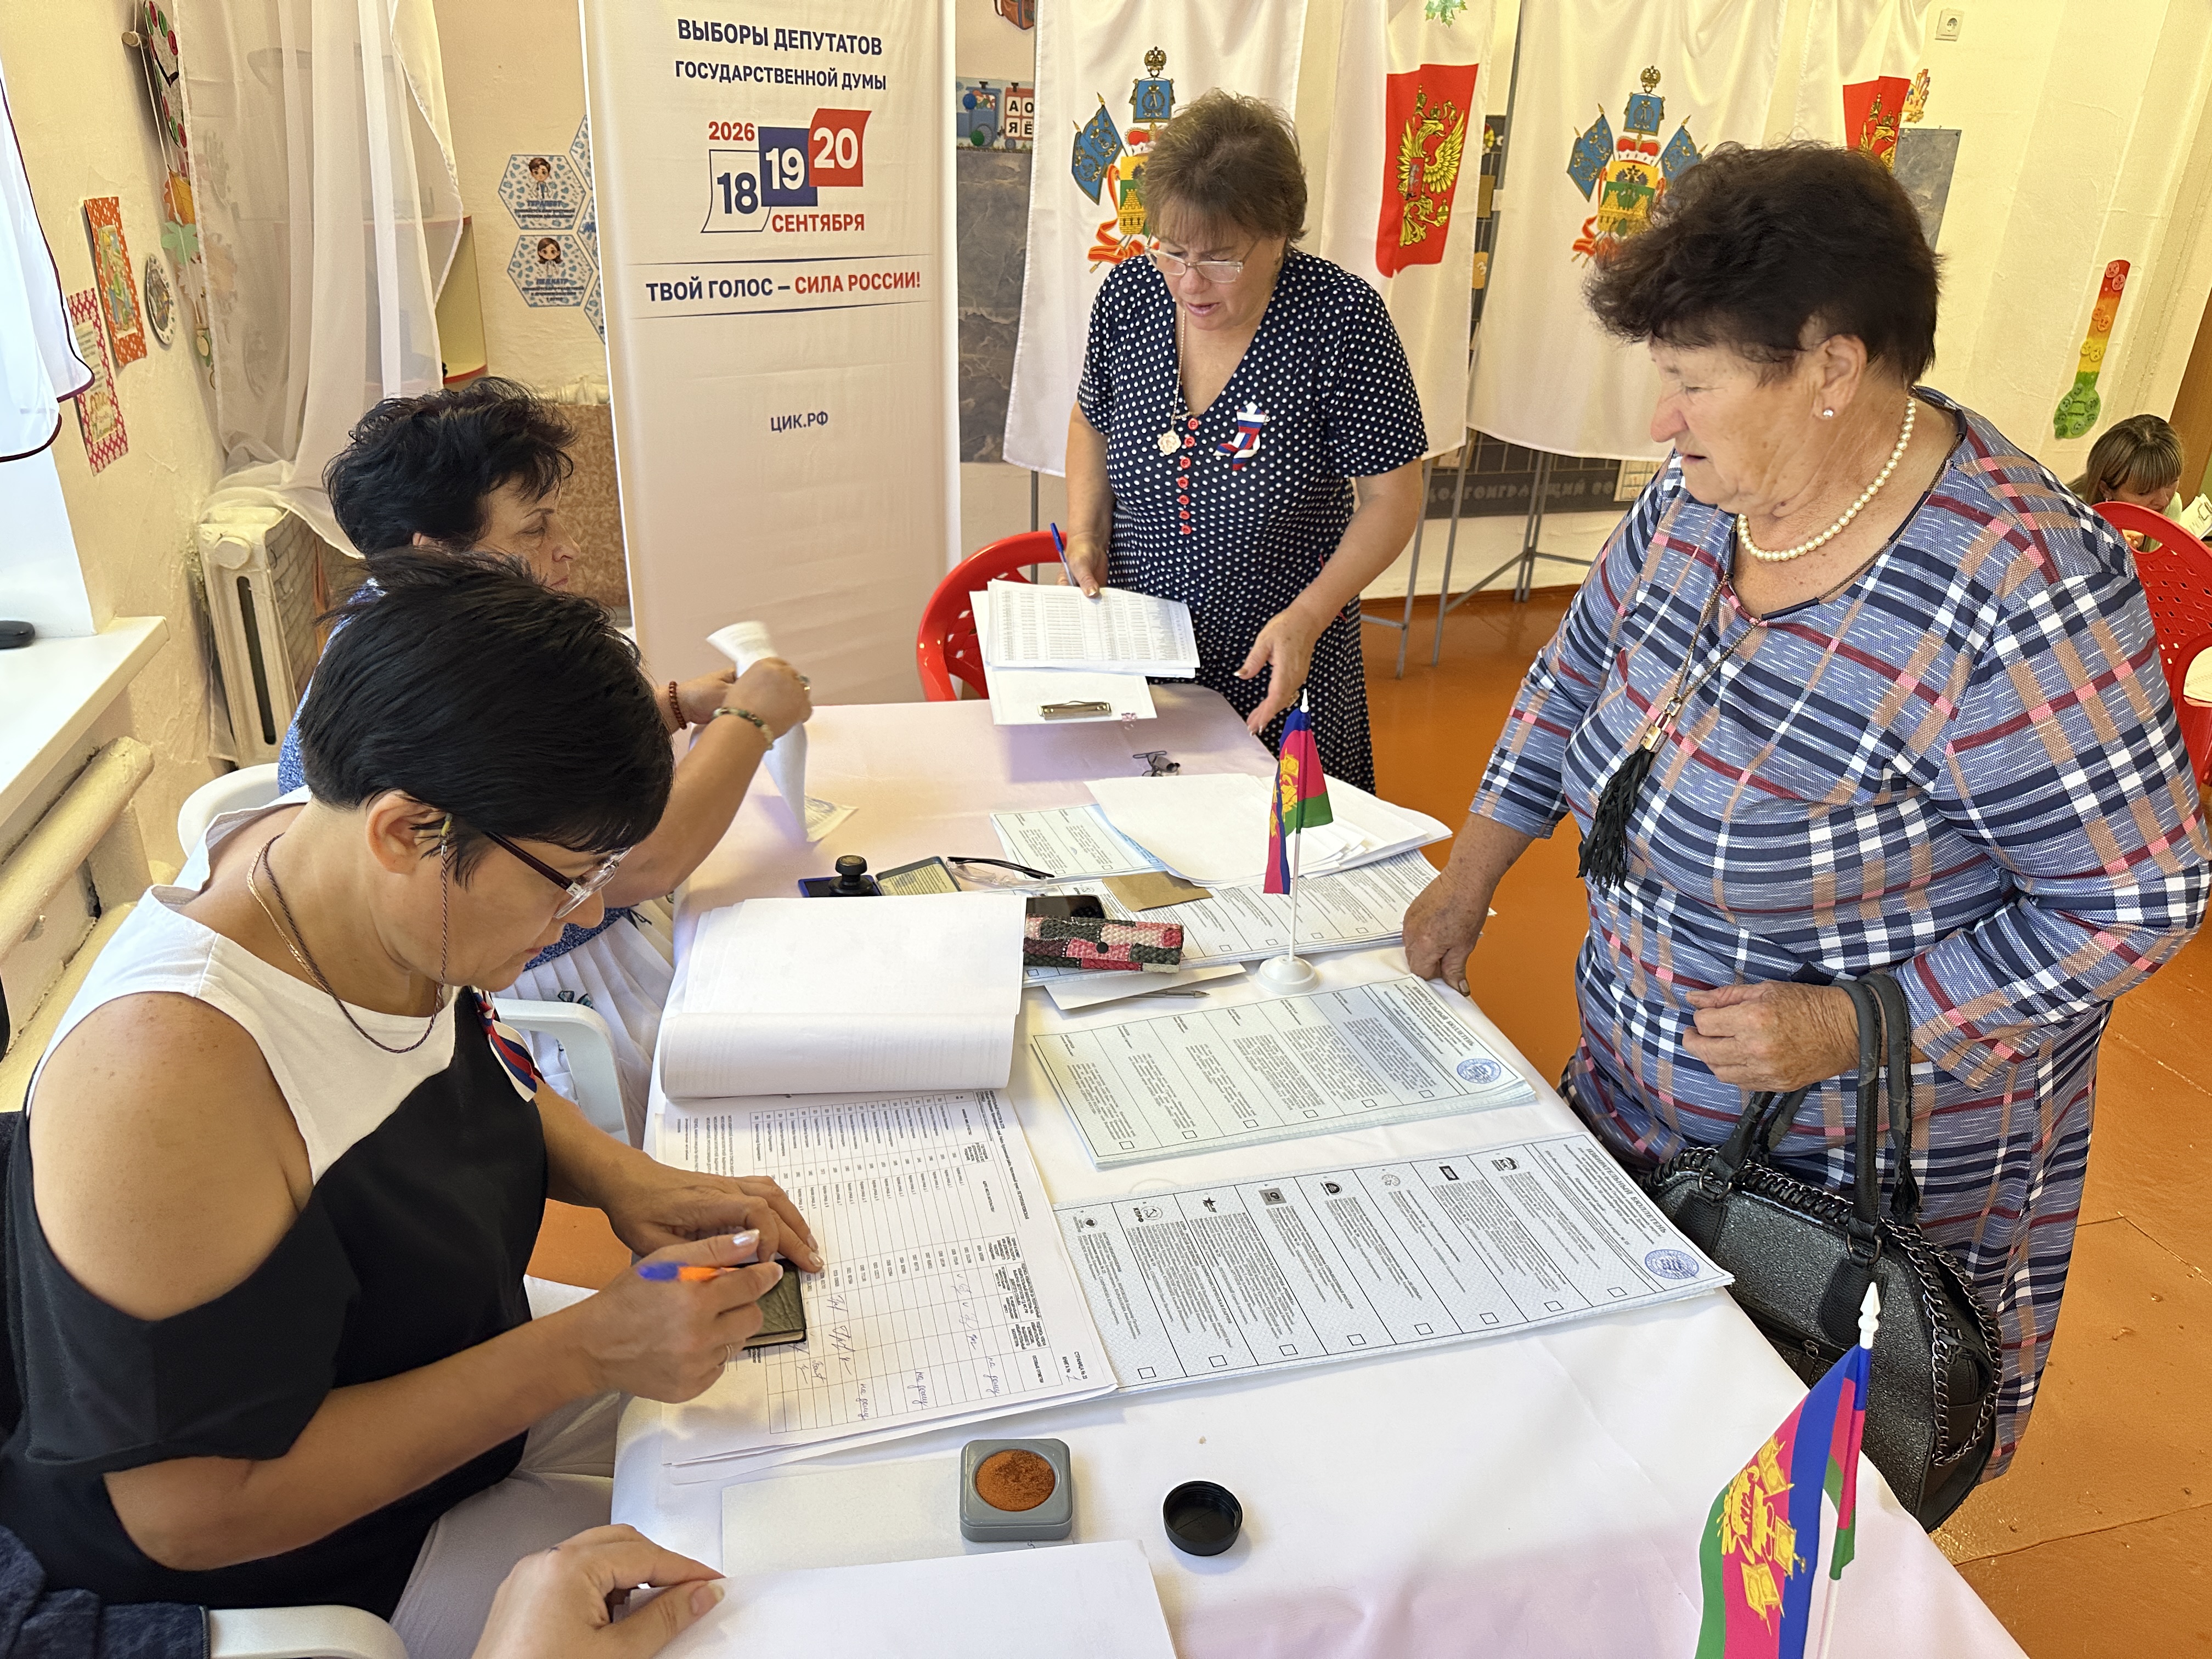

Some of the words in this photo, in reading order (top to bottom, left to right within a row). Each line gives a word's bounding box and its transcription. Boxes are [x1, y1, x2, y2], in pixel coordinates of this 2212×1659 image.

[678, 19, 768, 48] ВЫБОРЫ
[774, 27, 882, 56] ДЕПУТАТОВ
[675, 61, 838, 88] ГОСУДАРСТВЕННОЙ
[842, 74, 886, 90] ДУМЫ
[1009, 100, 1018, 112] А
[1025, 101, 1034, 114] О
[708, 121, 755, 141] 2026
[1008, 122, 1018, 133] Я
[1024, 121, 1032, 135] Ё
[717, 173, 758, 215] 18
[765, 148, 805, 190] 19
[813, 127, 859, 170] 20
[772, 213, 865, 233] СЕНТЯБРЯ
[646, 276, 702, 302] ТВОЙ
[709, 278, 772, 300] ГОЛОС
[795, 275, 843, 294] СИЛА
[848, 272, 921, 292] РОССИИ!
[771, 411, 828, 432] ЦИК.РФ
[1585, 1148, 1633, 1194] ИЗБИРАТЕЛЬНЫЙ
[1630, 1197, 1669, 1233] БЮЛЛЕТЕНЬ
[1132, 1207, 1144, 1222] КПРФ
[1072, 1351, 1085, 1371] СТРАНИЦА
